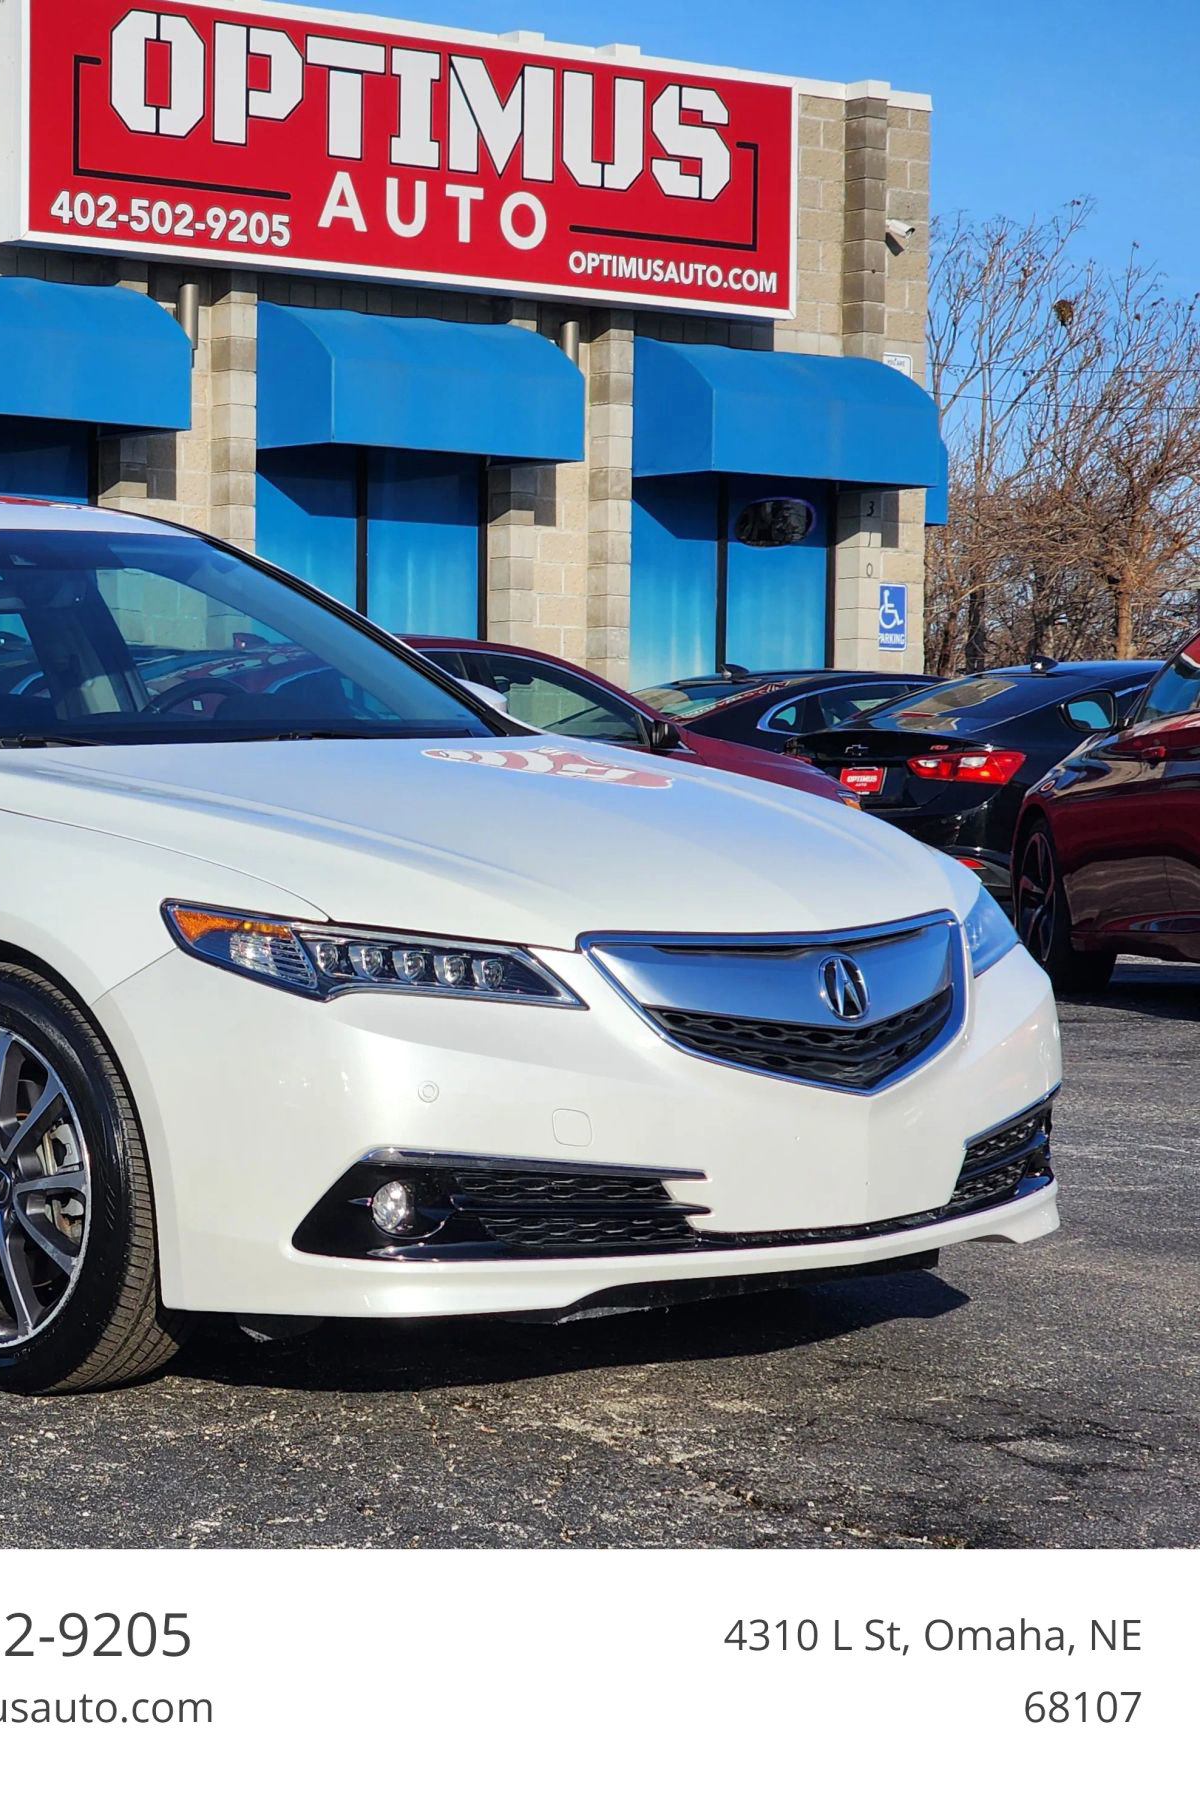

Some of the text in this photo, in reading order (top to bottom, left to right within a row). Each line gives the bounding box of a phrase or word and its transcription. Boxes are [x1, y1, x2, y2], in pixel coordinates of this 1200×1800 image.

[111, 10, 731, 200] OPTIMUS
[50, 190, 291, 247] 402-502-9205
[317, 171, 547, 250] AUTO
[568, 250, 777, 294] OPTIMUSAUTO.COM
[878, 633, 906, 645] PARKING
